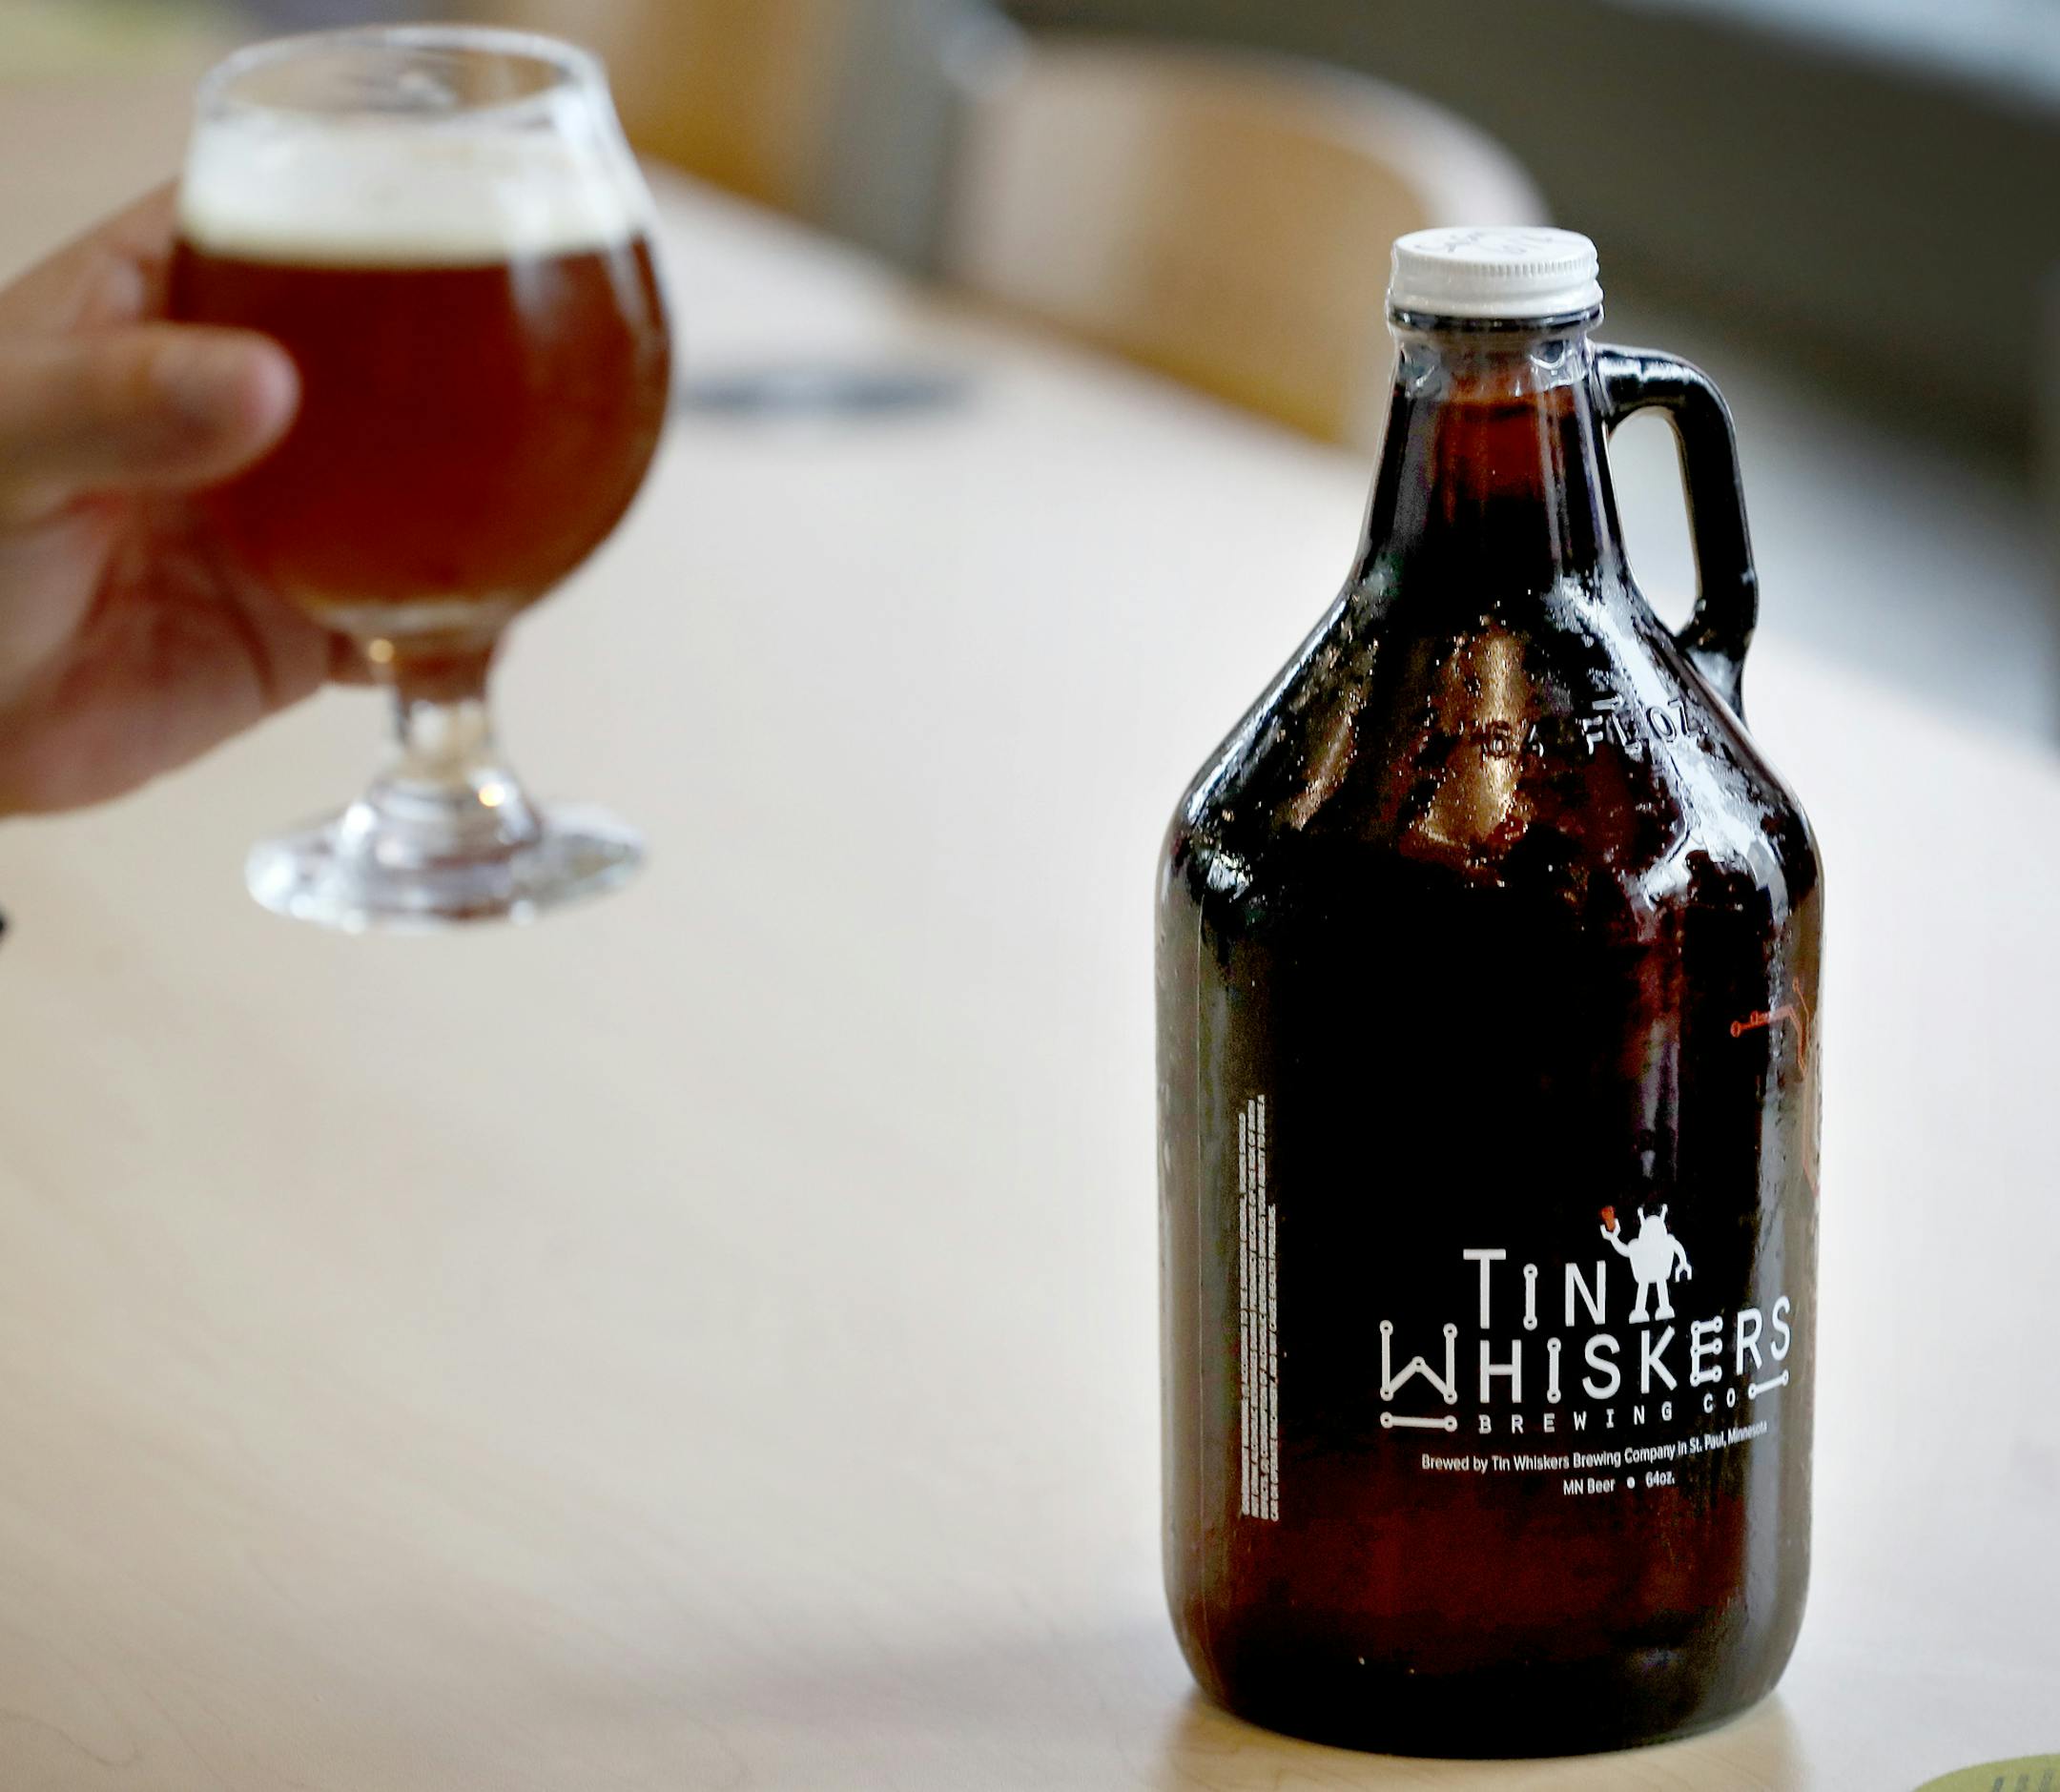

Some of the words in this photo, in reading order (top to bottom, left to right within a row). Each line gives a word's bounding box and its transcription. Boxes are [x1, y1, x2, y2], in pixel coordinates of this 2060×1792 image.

[1463, 1248, 1607, 1330] TIN
[1379, 1295, 1791, 1405] WHISKERS
[1478, 1401, 1673, 1434] BREWING
[1422, 1453, 1470, 1472] Brewed
[1473, 1455, 1489, 1474] by
[1492, 1454, 1511, 1472] Tin
[1513, 1453, 1570, 1472] Whiskers
[1573, 1451, 1622, 1469] Brewing
[1623, 1443, 1677, 1465] Company
[1677, 1440, 1687, 1456] in
[1689, 1436, 1703, 1454] St.
[1704, 1432, 1727, 1450] Paul,
[1562, 1478, 1584, 1496] MN
[1587, 1476, 1617, 1494] Beer
[1645, 1470, 1676, 1489] 64oz.
